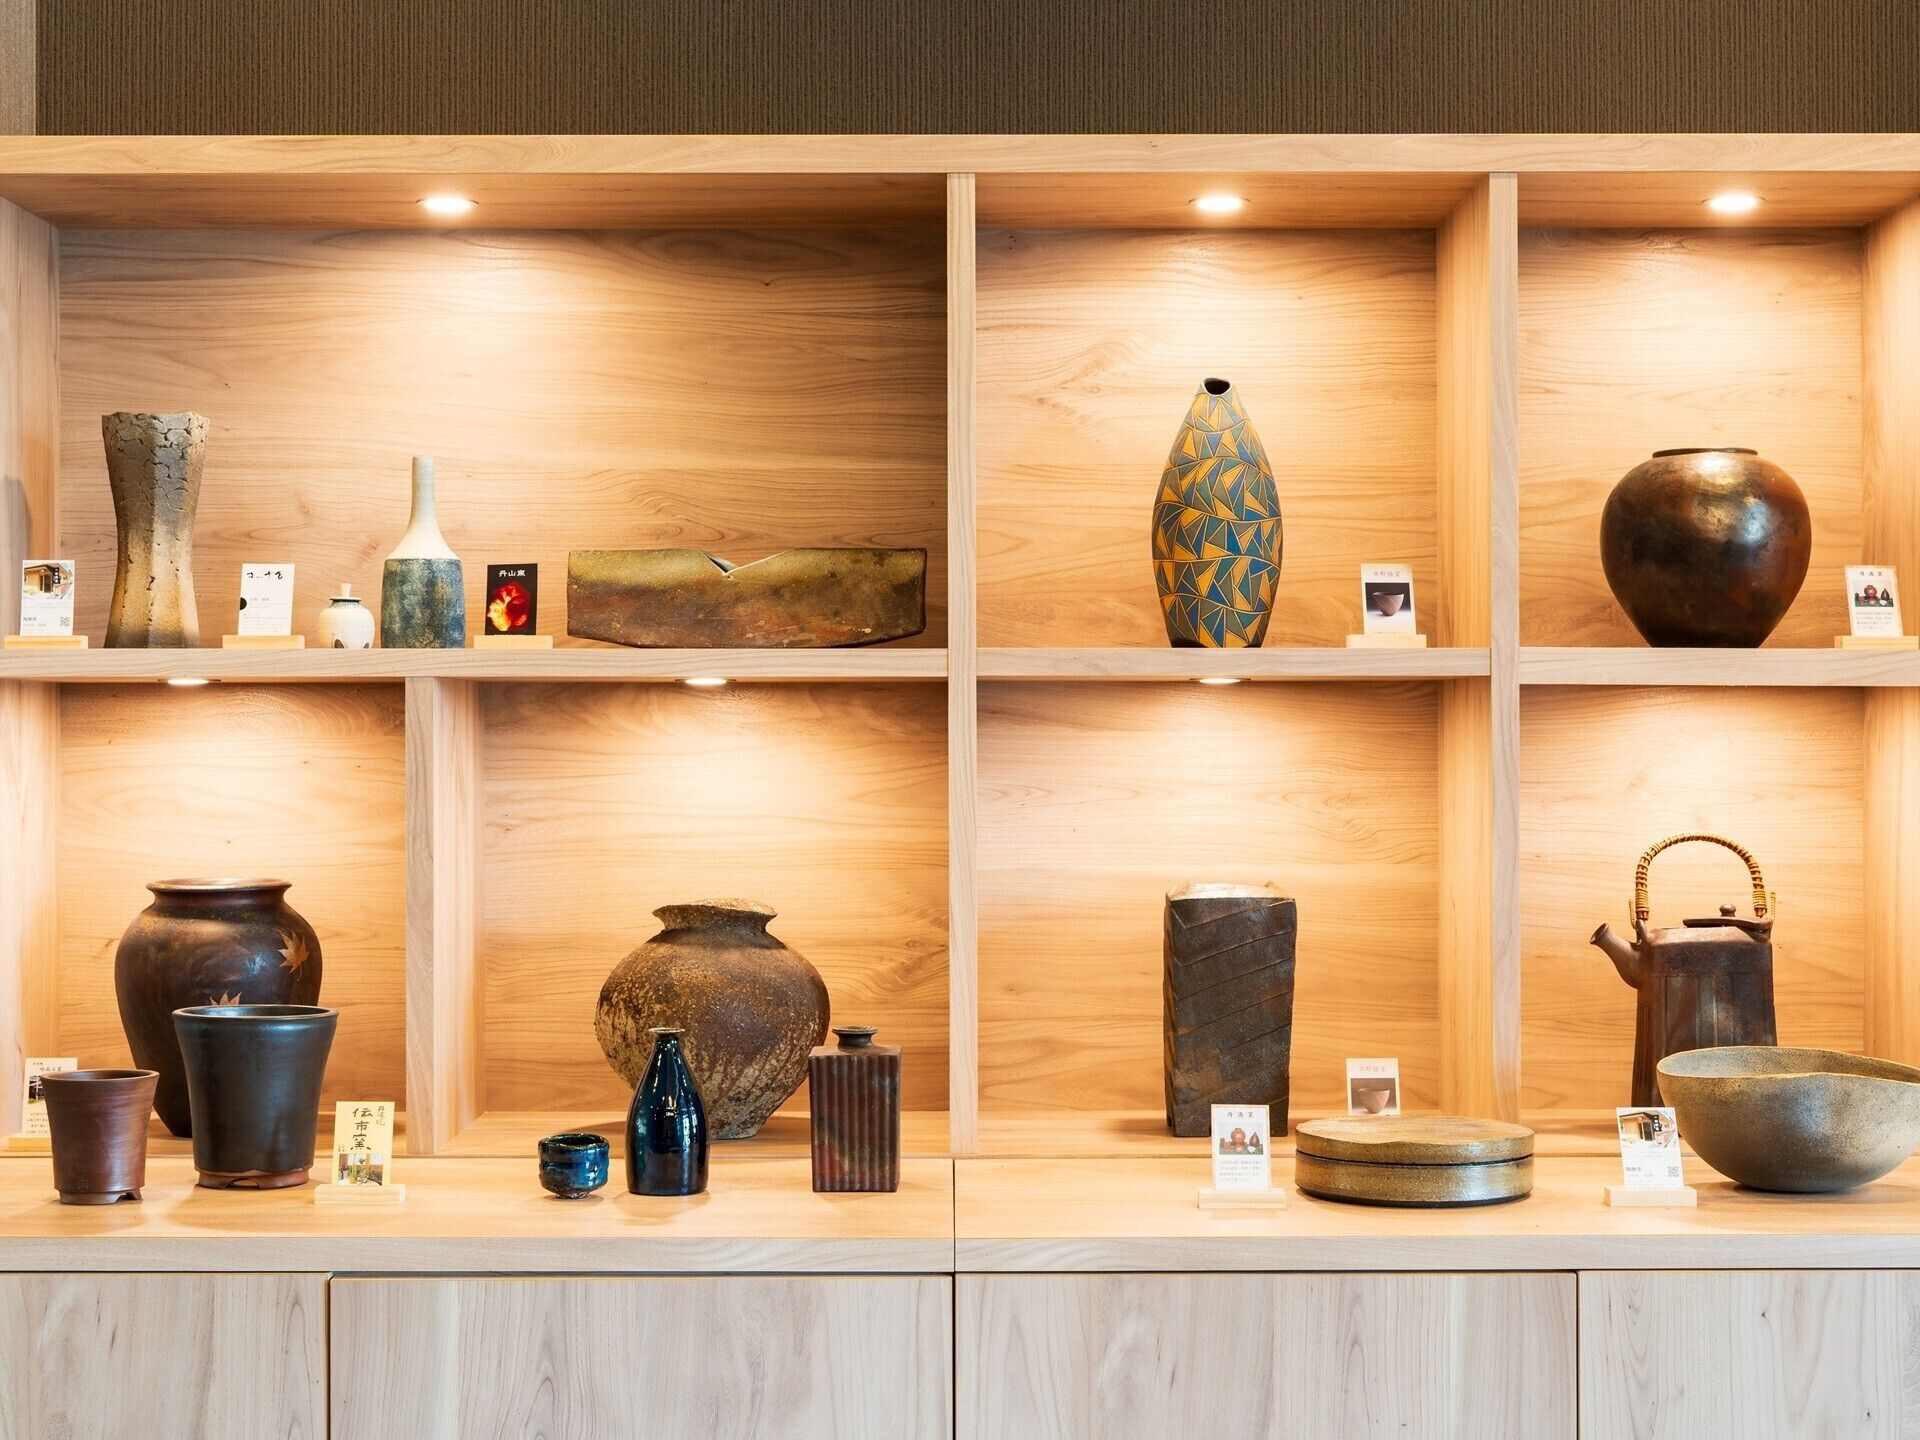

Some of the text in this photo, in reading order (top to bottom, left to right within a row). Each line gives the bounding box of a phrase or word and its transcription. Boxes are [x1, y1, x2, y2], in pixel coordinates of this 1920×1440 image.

[499, 569, 526, 577] 丹山窯
[350, 1108, 373, 1150] 伝市窯
